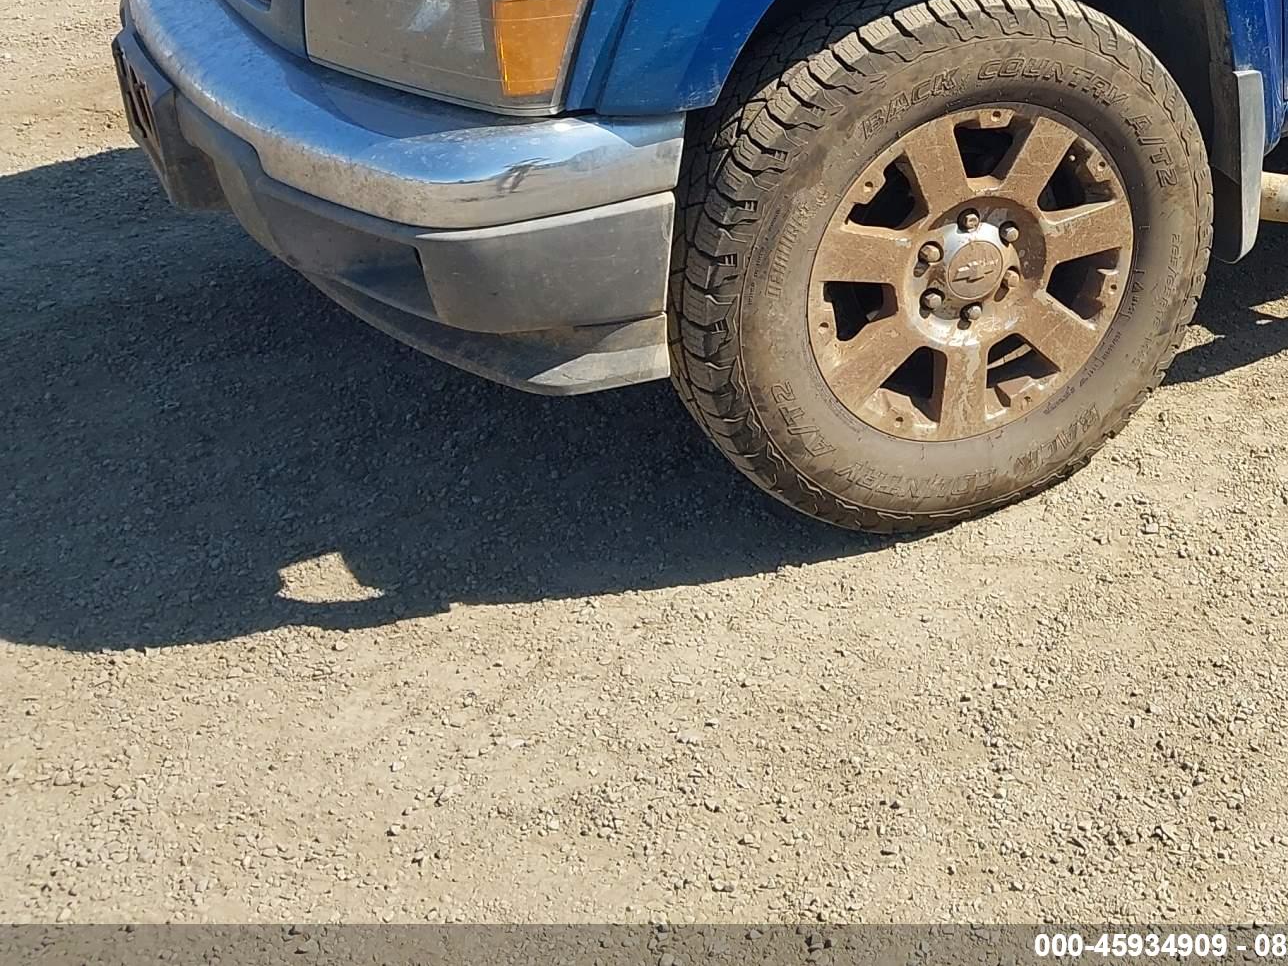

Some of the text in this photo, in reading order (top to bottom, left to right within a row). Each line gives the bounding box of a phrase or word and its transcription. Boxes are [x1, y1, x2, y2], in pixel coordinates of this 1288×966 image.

[862, 57, 1178, 188] BACK COUNTRY A/T2
